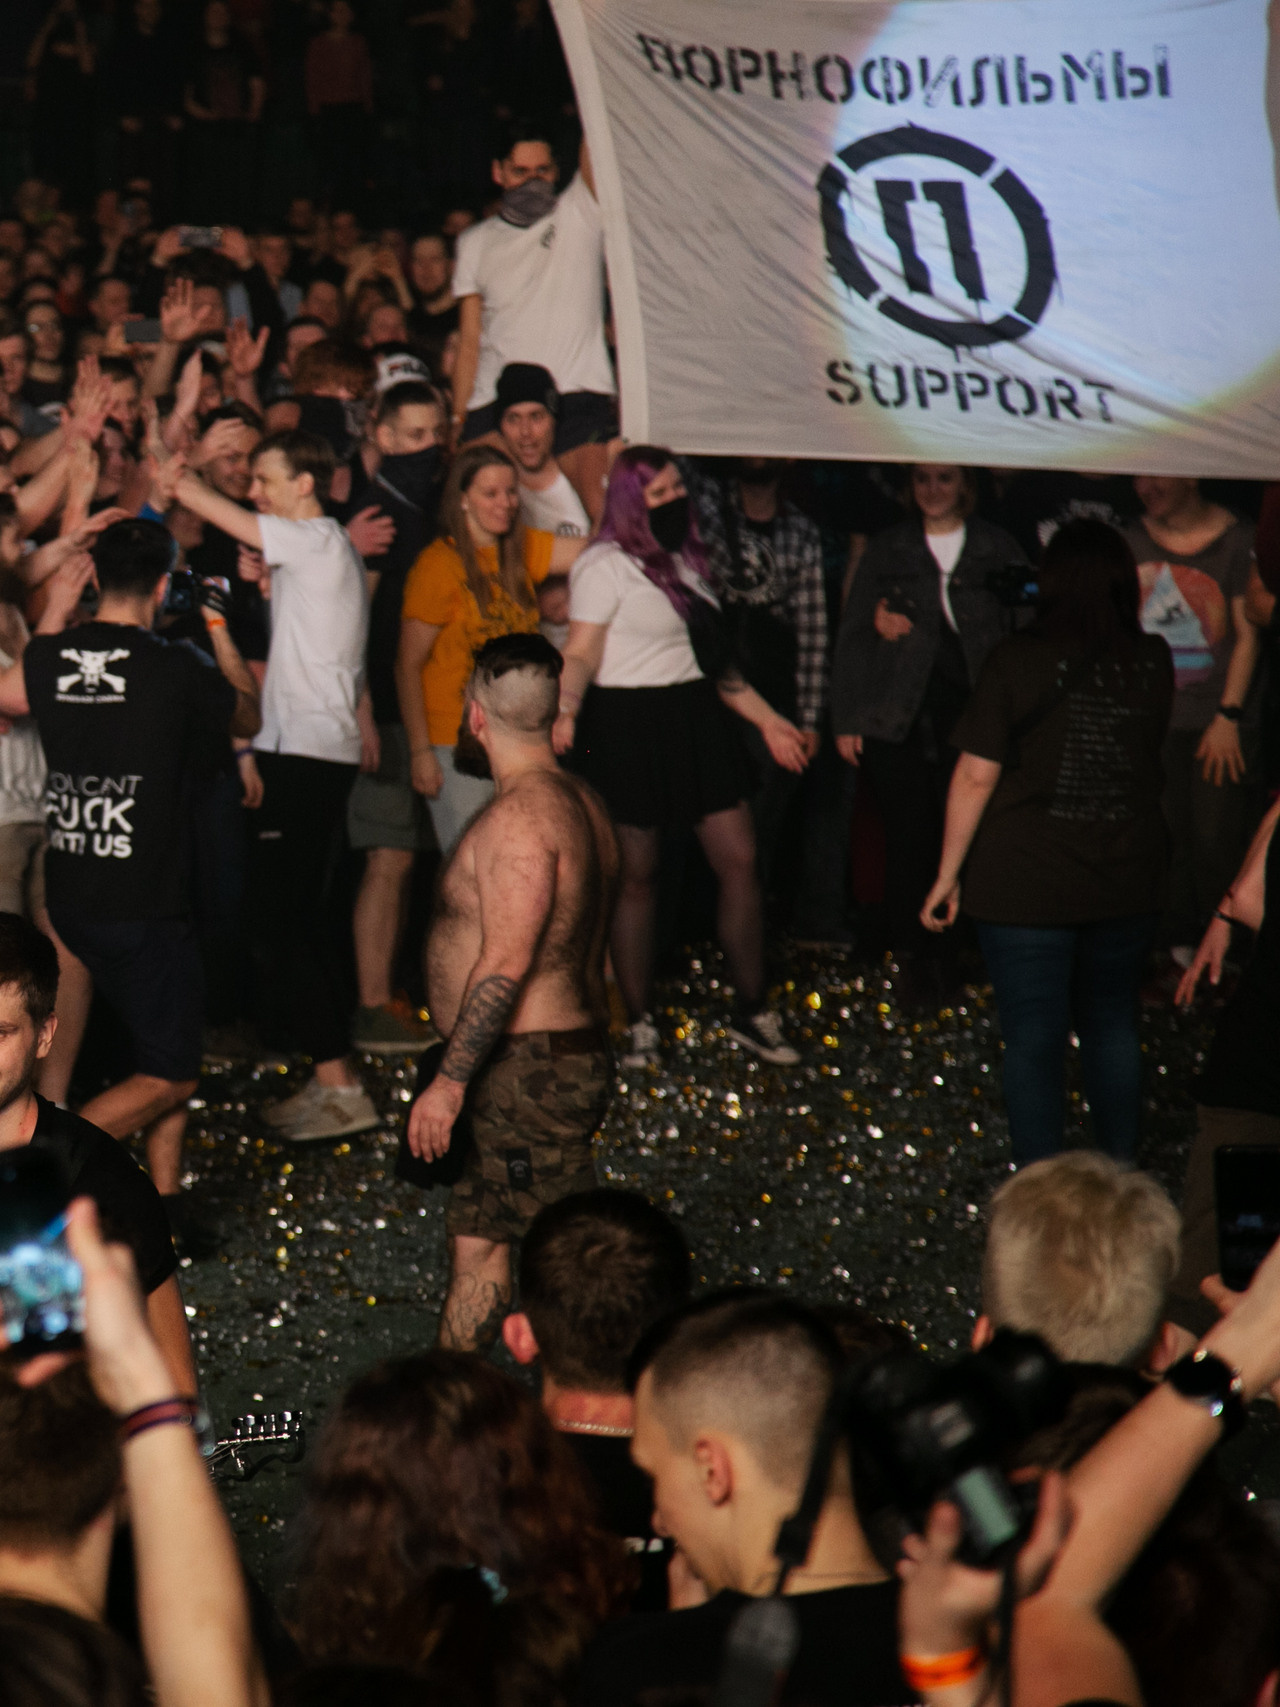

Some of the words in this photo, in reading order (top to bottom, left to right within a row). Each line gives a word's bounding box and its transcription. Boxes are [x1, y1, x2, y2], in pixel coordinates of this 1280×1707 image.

[636, 33, 1172, 107] ПОРНОФИЛЬМЫ
[825, 360, 1120, 424] SUPPORT
[92, 832, 133, 859] US
